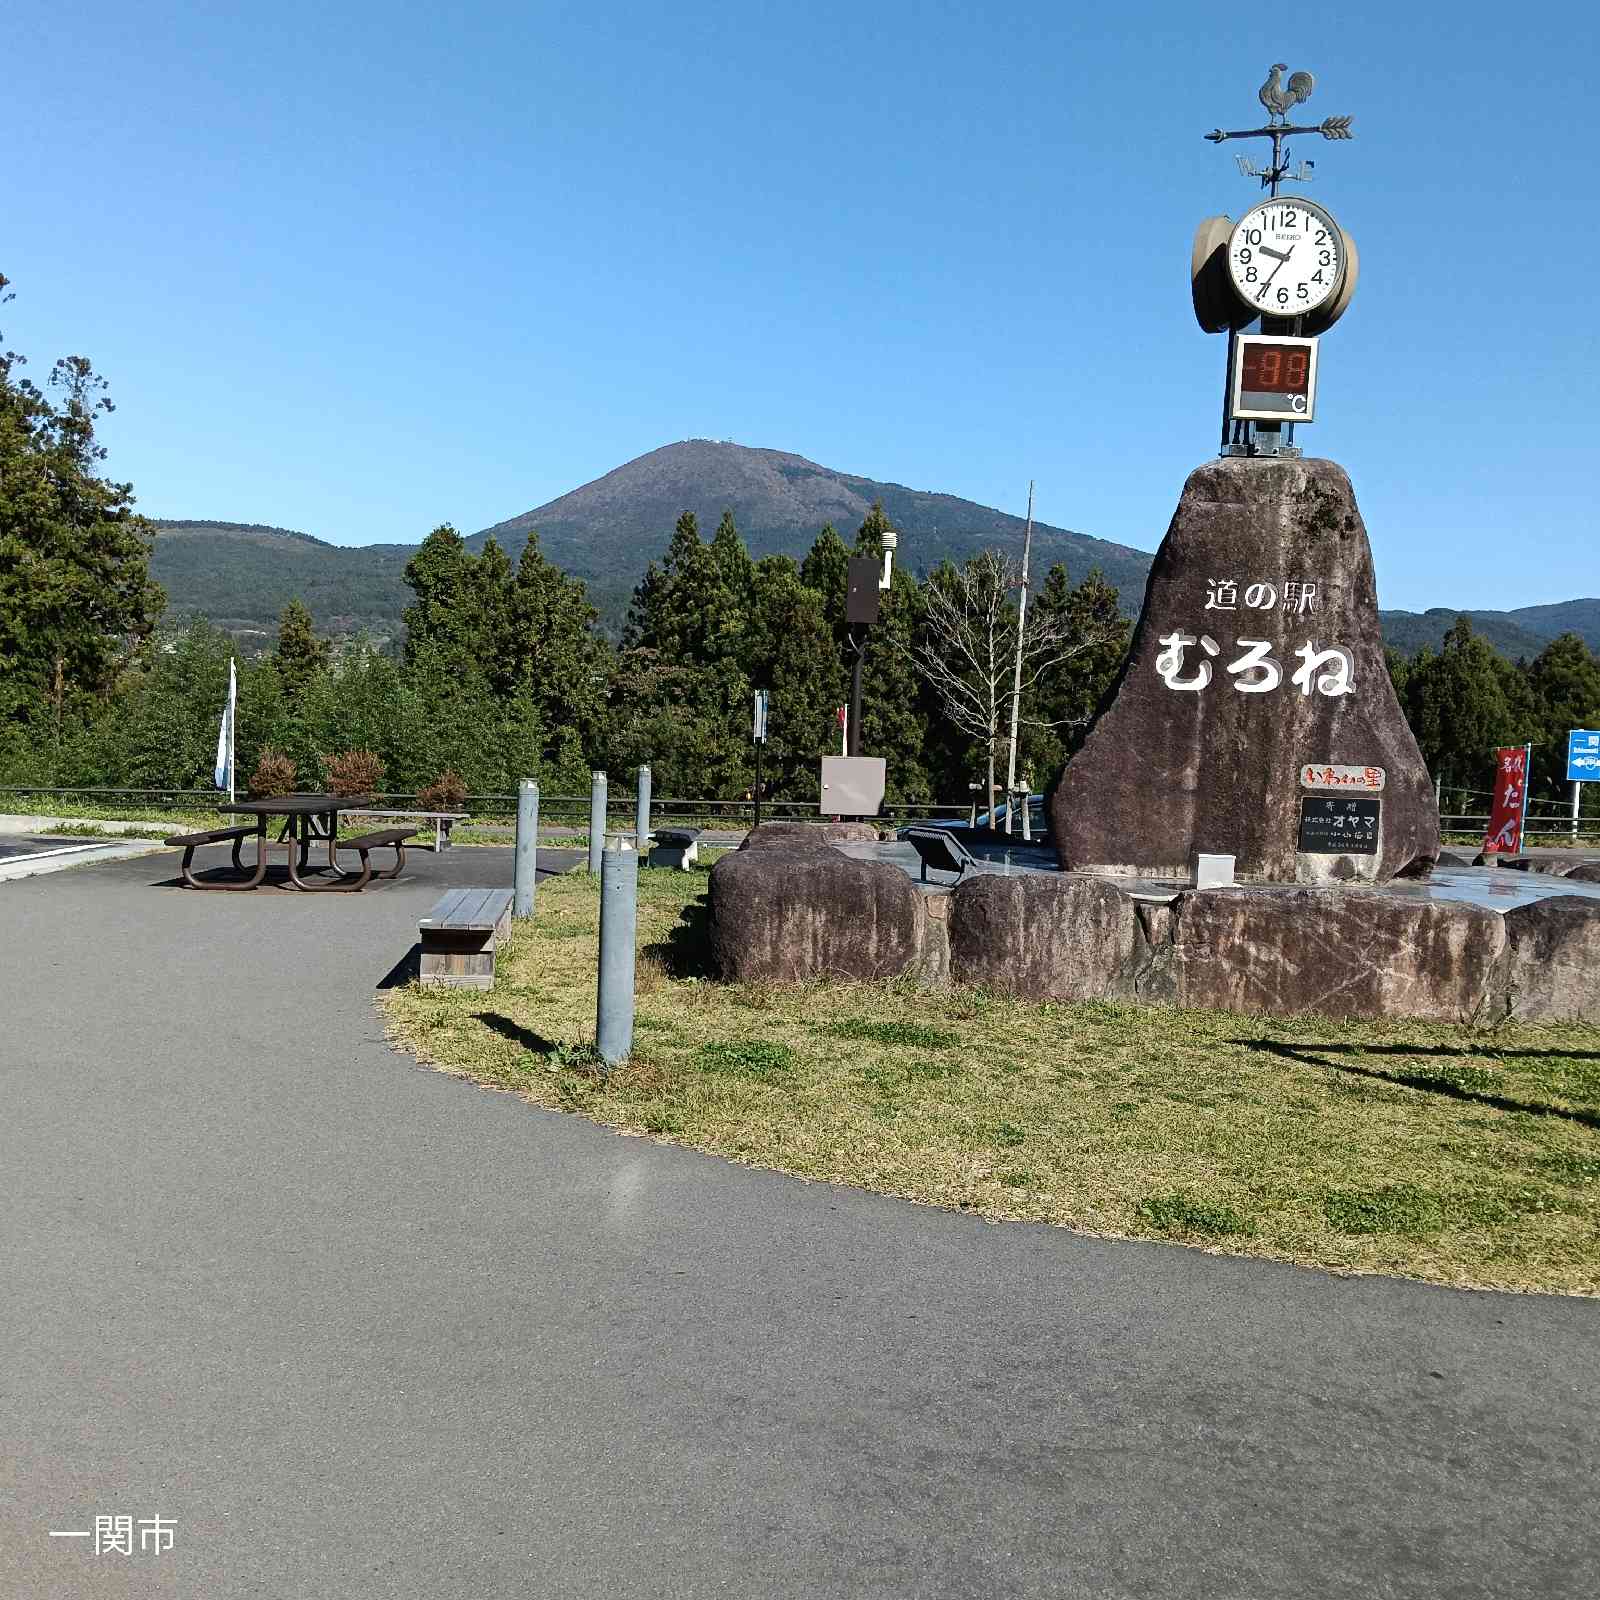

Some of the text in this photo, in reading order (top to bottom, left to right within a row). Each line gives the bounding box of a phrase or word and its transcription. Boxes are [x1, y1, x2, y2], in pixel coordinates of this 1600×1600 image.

[1263, 215, 1276, 231] 11
[1280, 210, 1297, 228] 12
[1305, 215, 1310, 232] 1
[1245, 229, 1262, 246] 10
[1314, 230, 1327, 246] 2
[1239, 248, 1252, 265] 9
[1318, 250, 1331, 267] 3
[1245, 266, 1258, 283] 8
[1311, 269, 1324, 285] 4
[1260, 282, 1272, 298] 7
[1276, 287, 1289, 304] 6
[1297, 282, 1308, 299] 5
[1204, 578, 1316, 614] 道の駅
[1155, 628, 1357, 697] むろね
